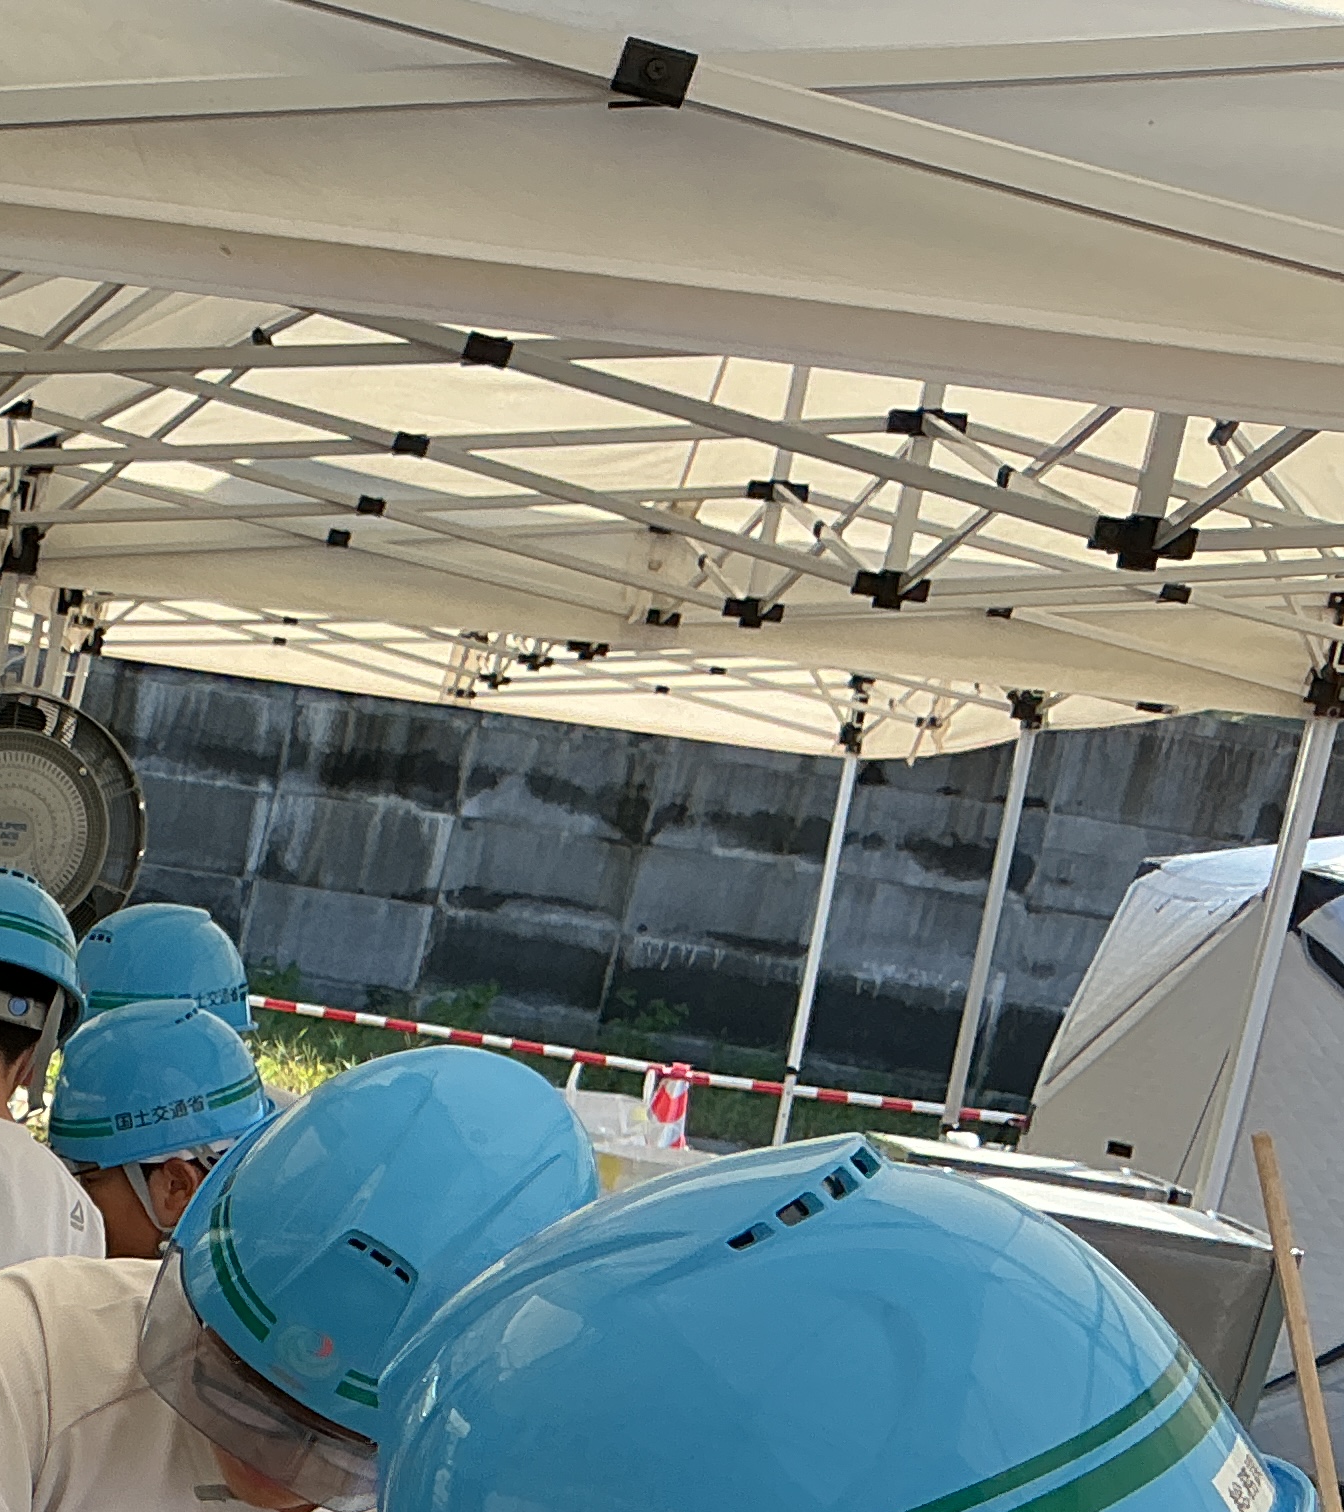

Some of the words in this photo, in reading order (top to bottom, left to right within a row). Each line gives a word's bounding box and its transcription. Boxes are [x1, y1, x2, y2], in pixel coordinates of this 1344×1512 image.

[114, 1095, 205, 1131] 国土交通省
